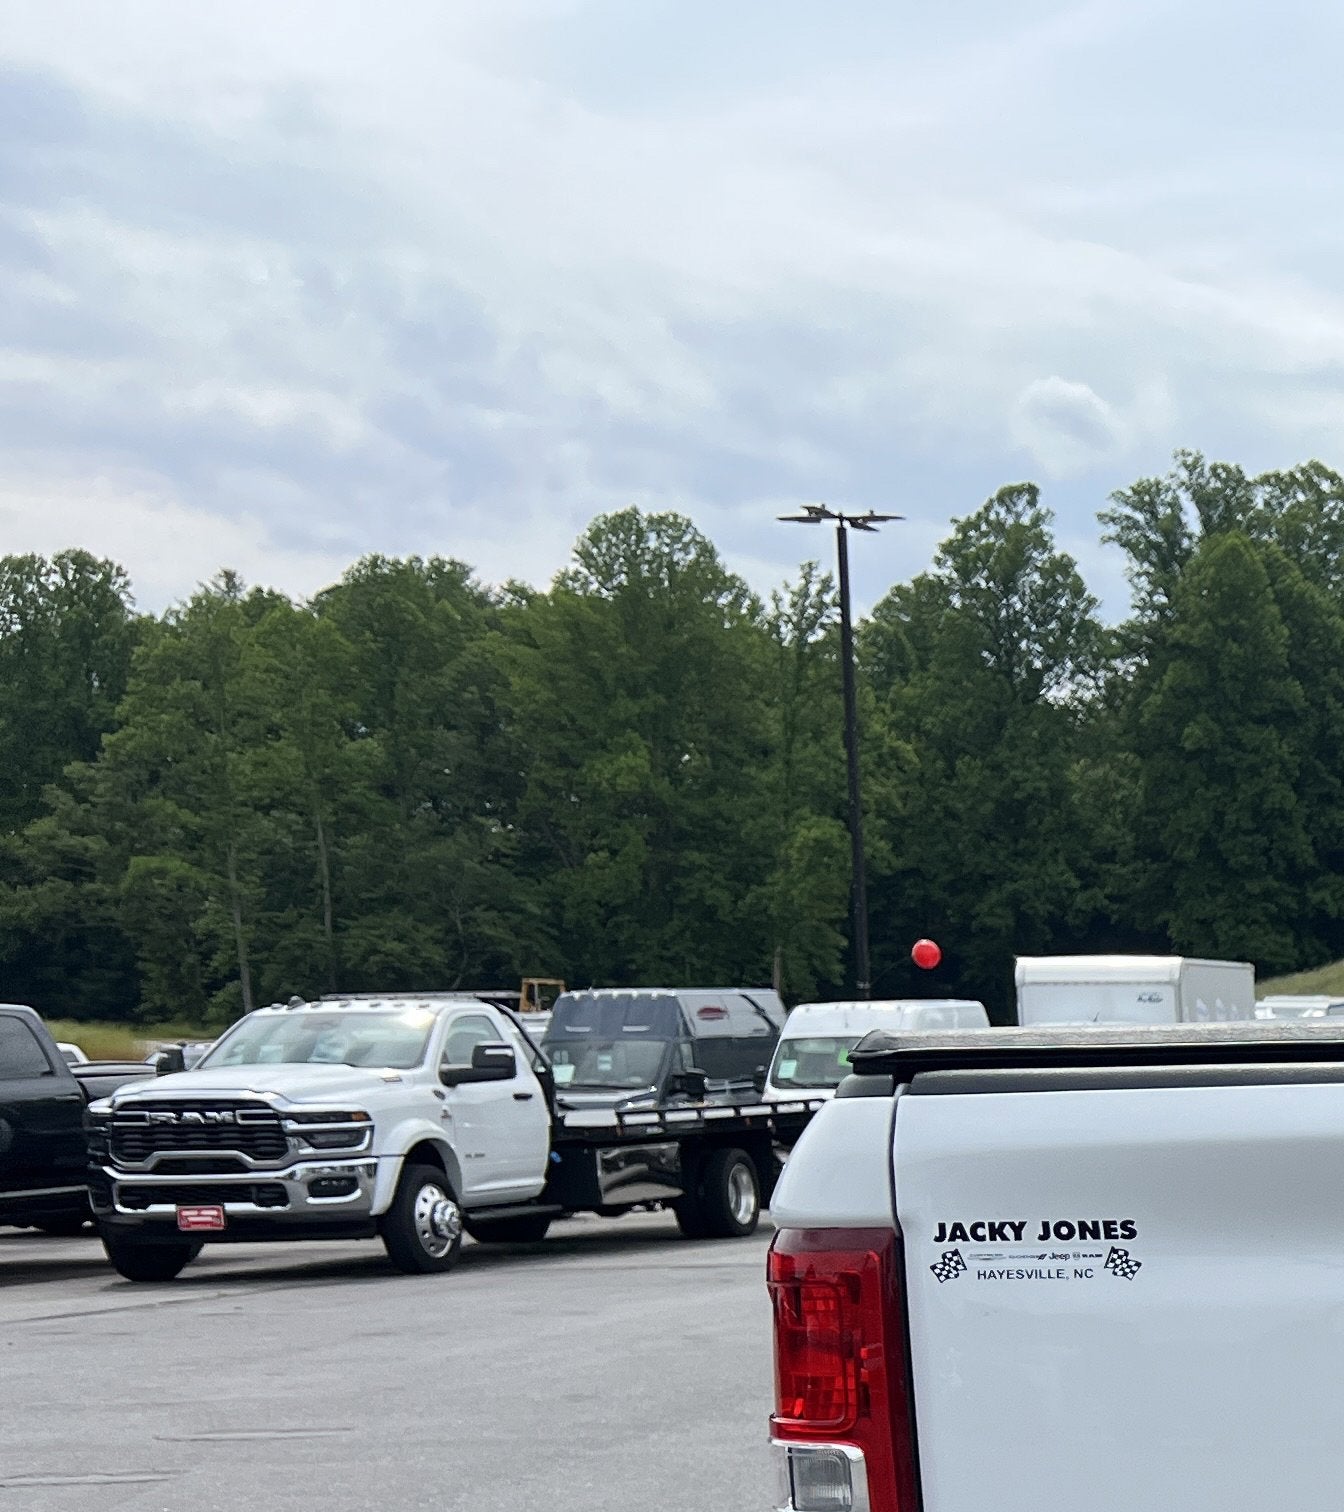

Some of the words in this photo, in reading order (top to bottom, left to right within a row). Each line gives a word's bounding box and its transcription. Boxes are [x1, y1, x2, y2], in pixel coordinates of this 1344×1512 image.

[933, 1221, 1027, 1243] JACKY
[1037, 1219, 1138, 1241] JONES
[1049, 1252, 1071, 1261] Jeep
[977, 1268, 1070, 1280] HAYESVILLE,
[1074, 1268, 1094, 1279] NC
